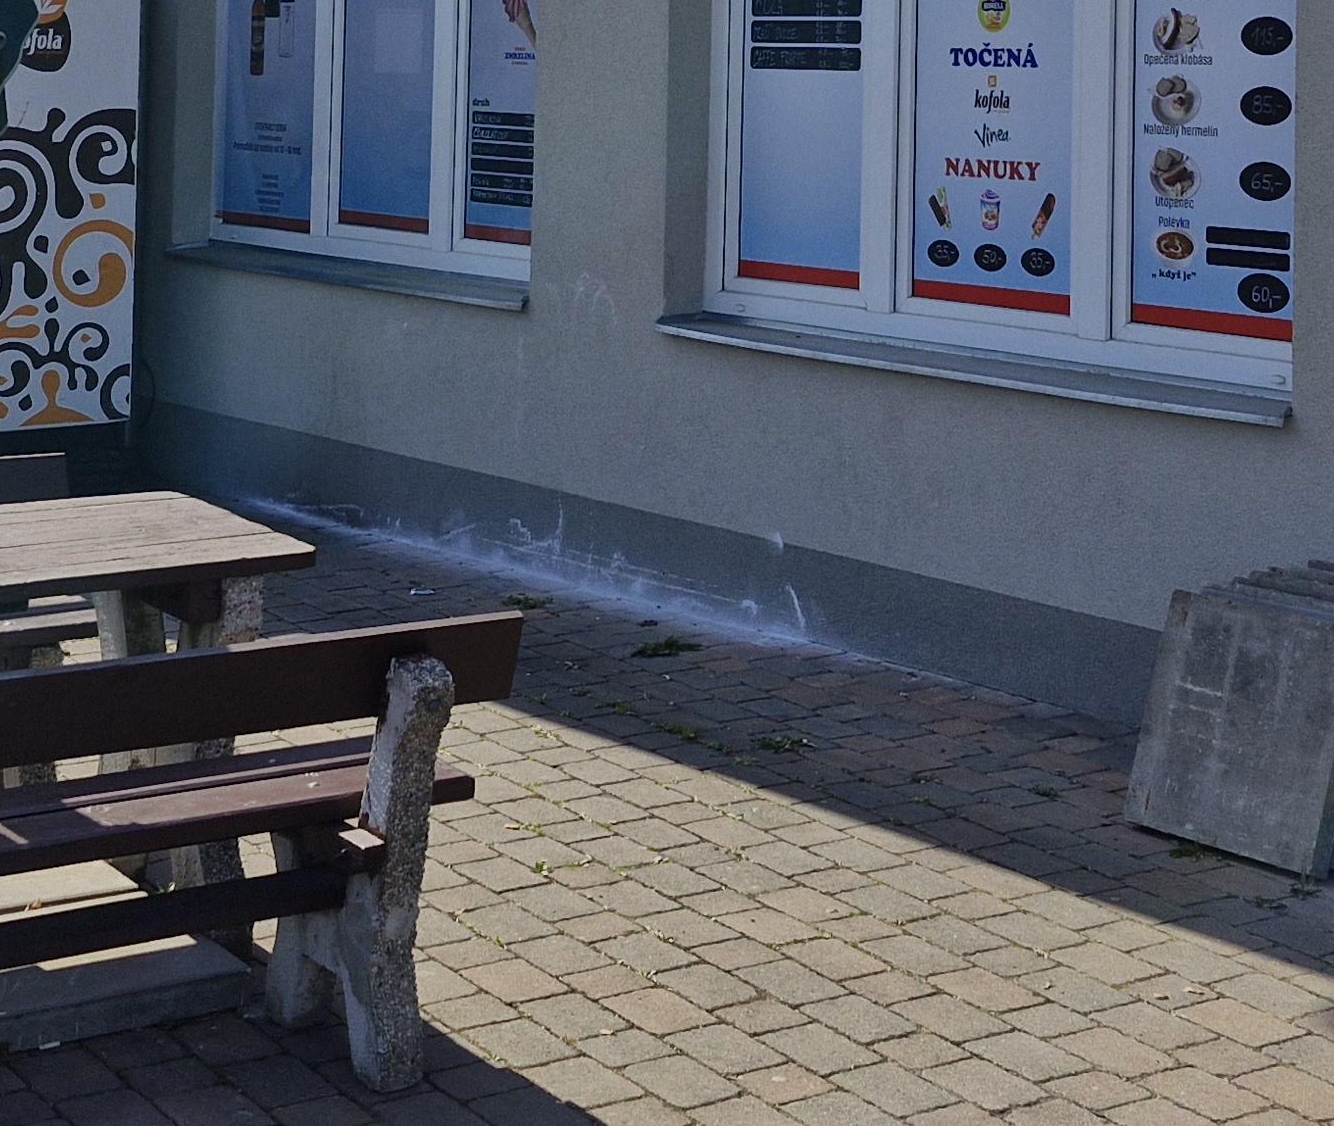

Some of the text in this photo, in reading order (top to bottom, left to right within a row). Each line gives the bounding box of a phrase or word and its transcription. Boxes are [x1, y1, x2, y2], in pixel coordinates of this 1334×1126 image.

[950, 43, 1039, 68] TOČENÁ
[974, 89, 1010, 114] kofola
[974, 123, 1009, 148] Vinea
[945, 158, 1041, 182] NANUKY
